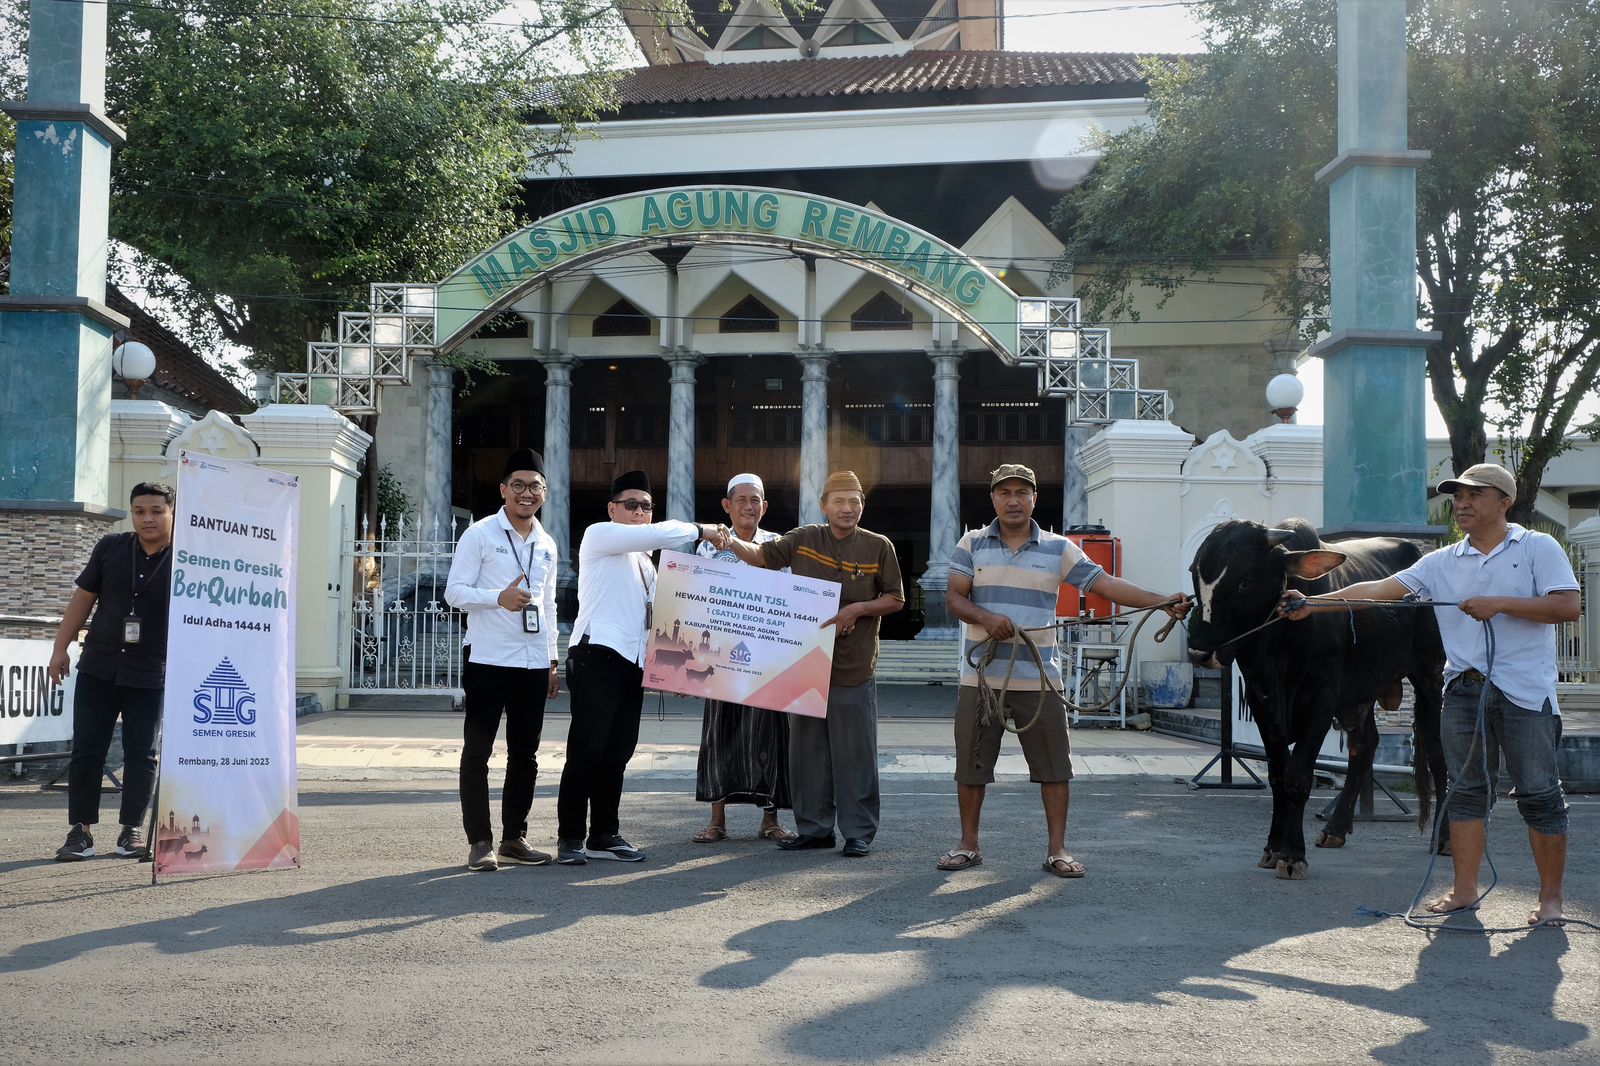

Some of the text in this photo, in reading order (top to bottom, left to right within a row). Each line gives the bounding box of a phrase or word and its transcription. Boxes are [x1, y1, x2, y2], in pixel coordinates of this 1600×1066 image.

[470, 190, 988, 305] MASJID AGUNG REMBANG
[190, 514, 277, 541] BANTUAN TJSL
[177, 549, 283, 578] Semen Gresik
[173, 569, 287, 610] BerQurban
[709, 585, 788, 607] BANTUAN TJSL
[675, 591, 819, 623] HEWAN QURBAN IDUL ADHA 1444H
[711, 608, 740, 620] (SATU)
[742, 613, 765, 624] EKOR
[766, 618, 785, 628] SAPI
[183, 614, 271, 633] Idul Adha 1444 H
[684, 620, 803, 646] KABUPATEN REMBANG, JAWA TENGAH
[709, 618, 780, 635] UNTUK MASJID AGUNG
[192, 729, 257, 738] SEMEN GRESIK
[178, 757, 270, 767] Rembang, 28 Juni 2023
